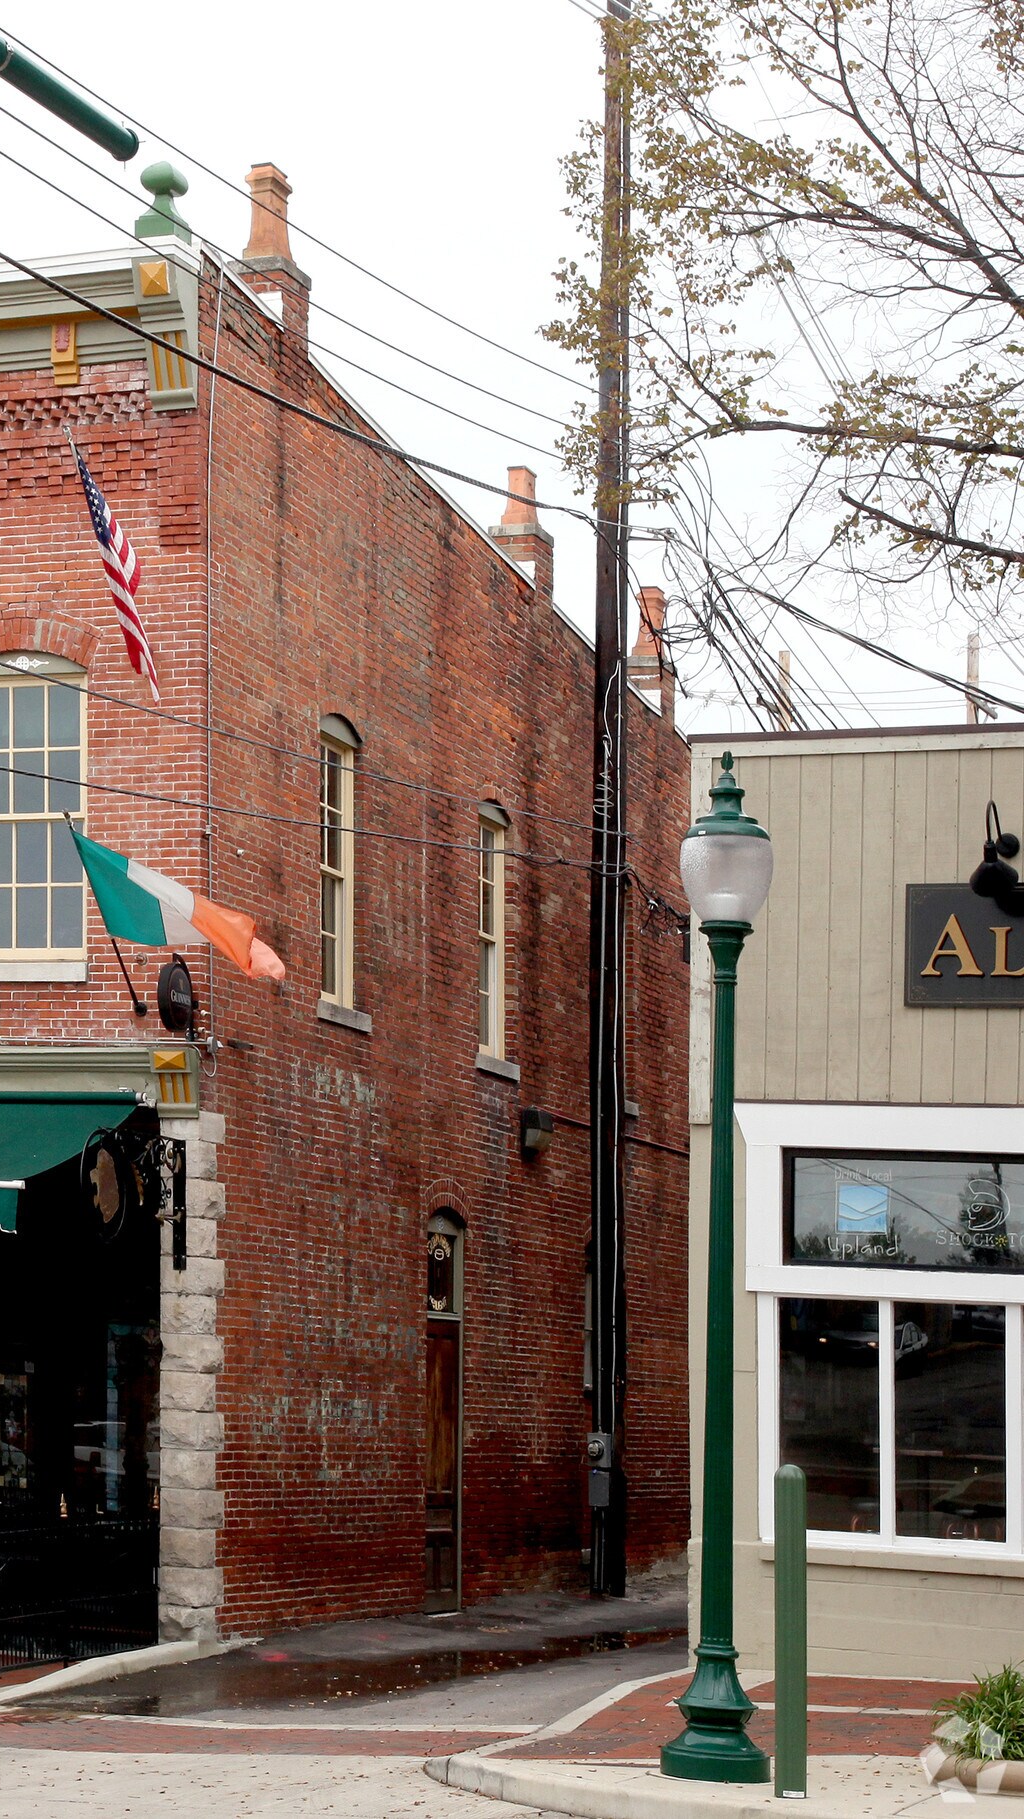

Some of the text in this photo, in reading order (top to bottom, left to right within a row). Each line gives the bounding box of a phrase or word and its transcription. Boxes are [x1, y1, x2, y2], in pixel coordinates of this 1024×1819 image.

[920, 913, 1024, 977] AL
[834, 1167, 892, 1182] Drink Local
[828, 1234, 899, 1260] Upland
[936, 1230, 995, 1247] SHOCK
